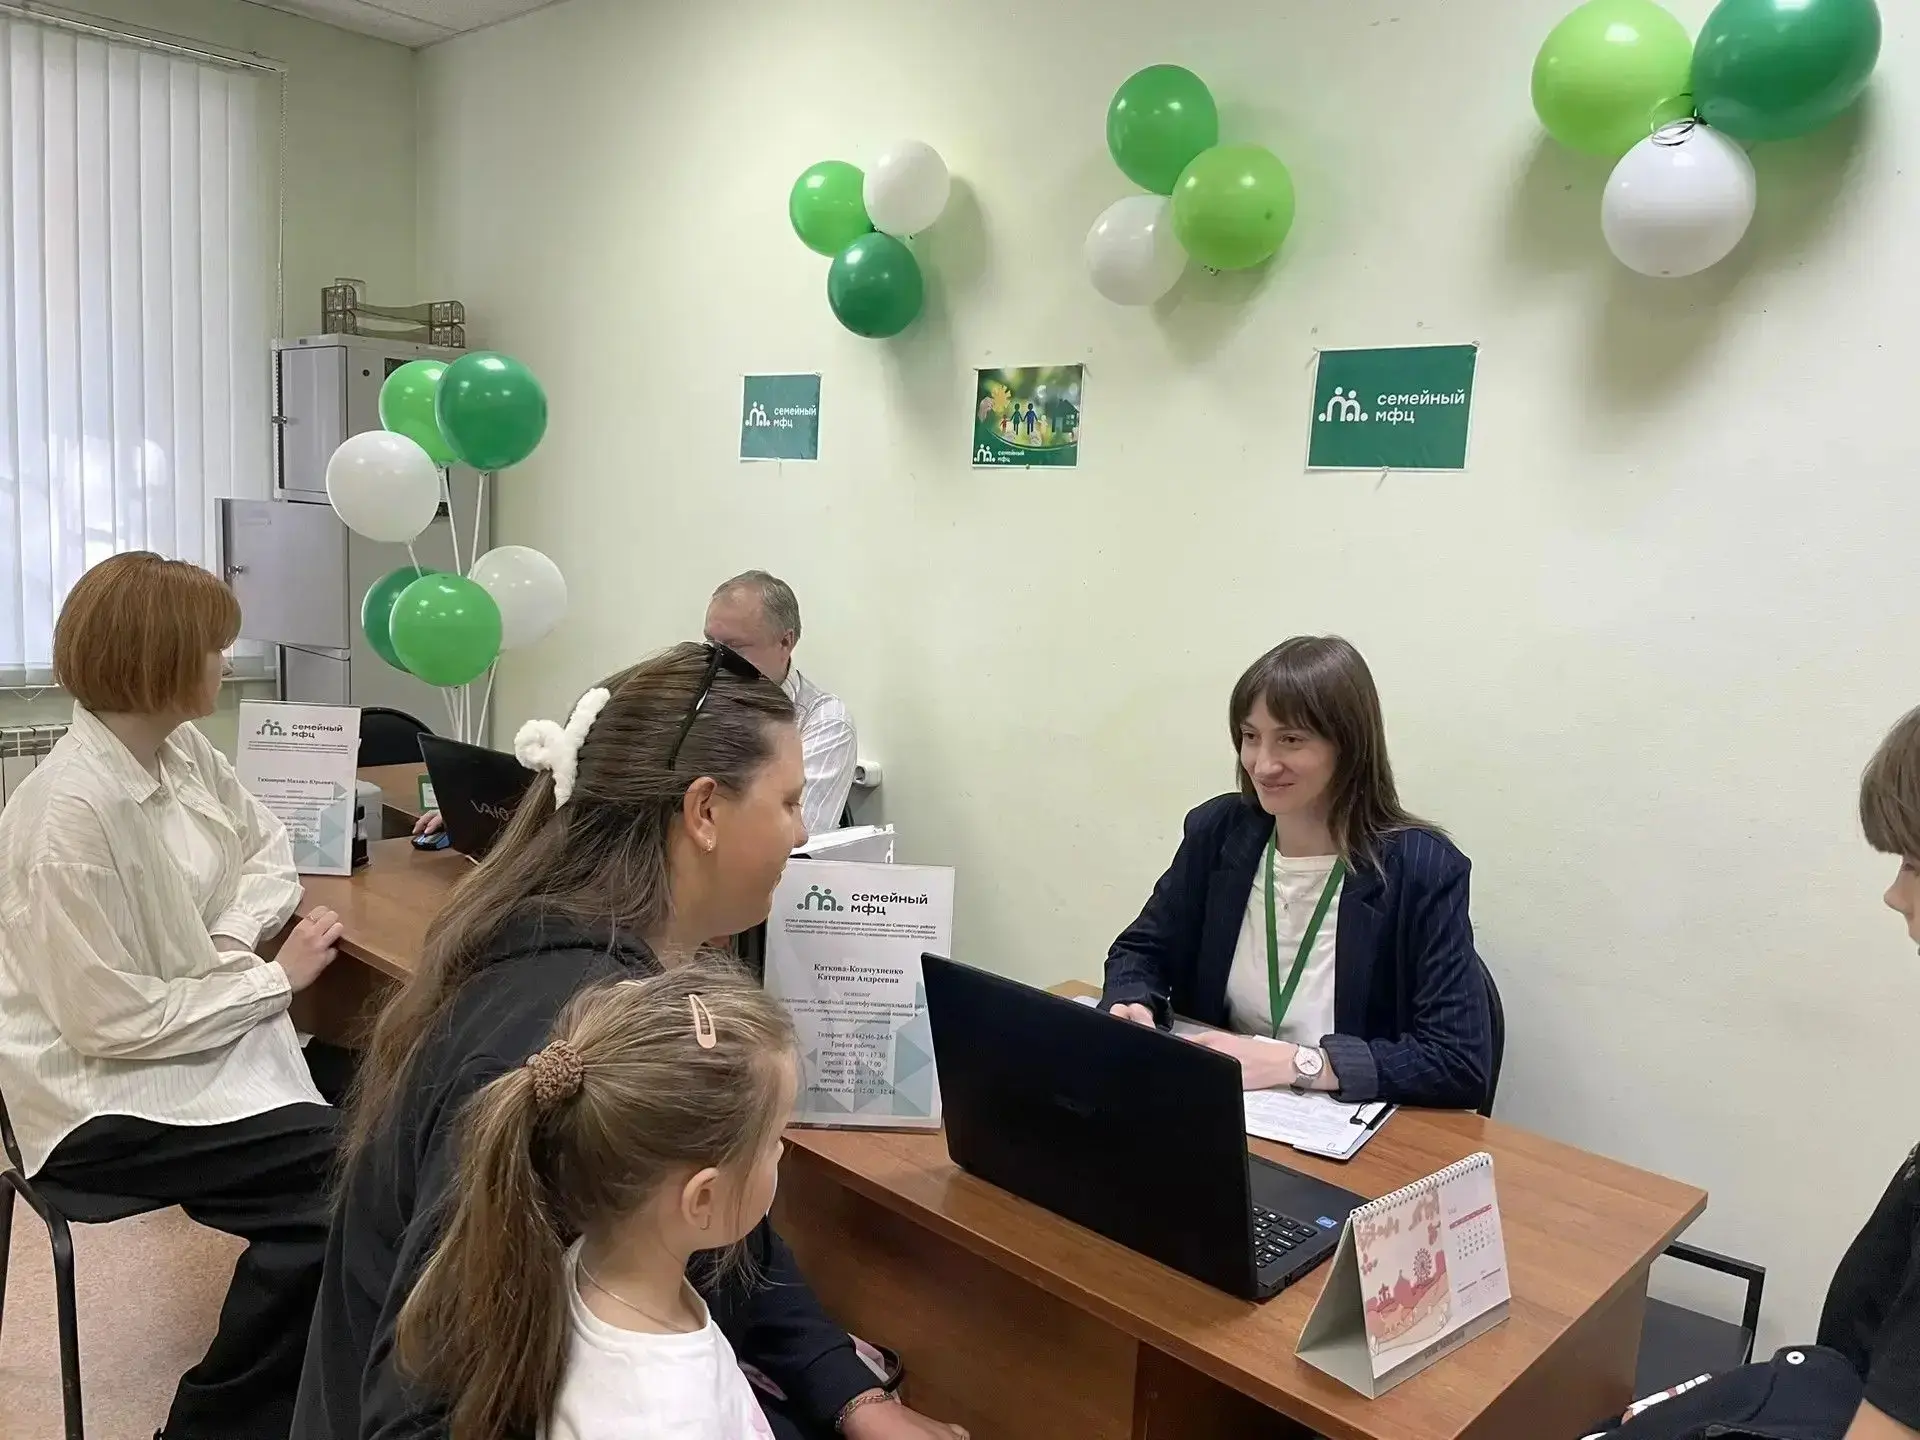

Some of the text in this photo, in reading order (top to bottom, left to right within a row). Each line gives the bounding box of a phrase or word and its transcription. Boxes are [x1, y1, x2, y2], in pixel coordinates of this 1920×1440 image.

[1377, 389, 1465, 406] семейный
[773, 405, 817, 416] семейный
[1375, 407, 1415, 425] мфц
[773, 416, 793, 429] мфц
[292, 723, 343, 732] семейный
[291, 731, 315, 739] мфц
[851, 892, 929, 905] семейный
[850, 903, 886, 916] мфц
[817, 973, 899, 985] Катерина Андреевна
